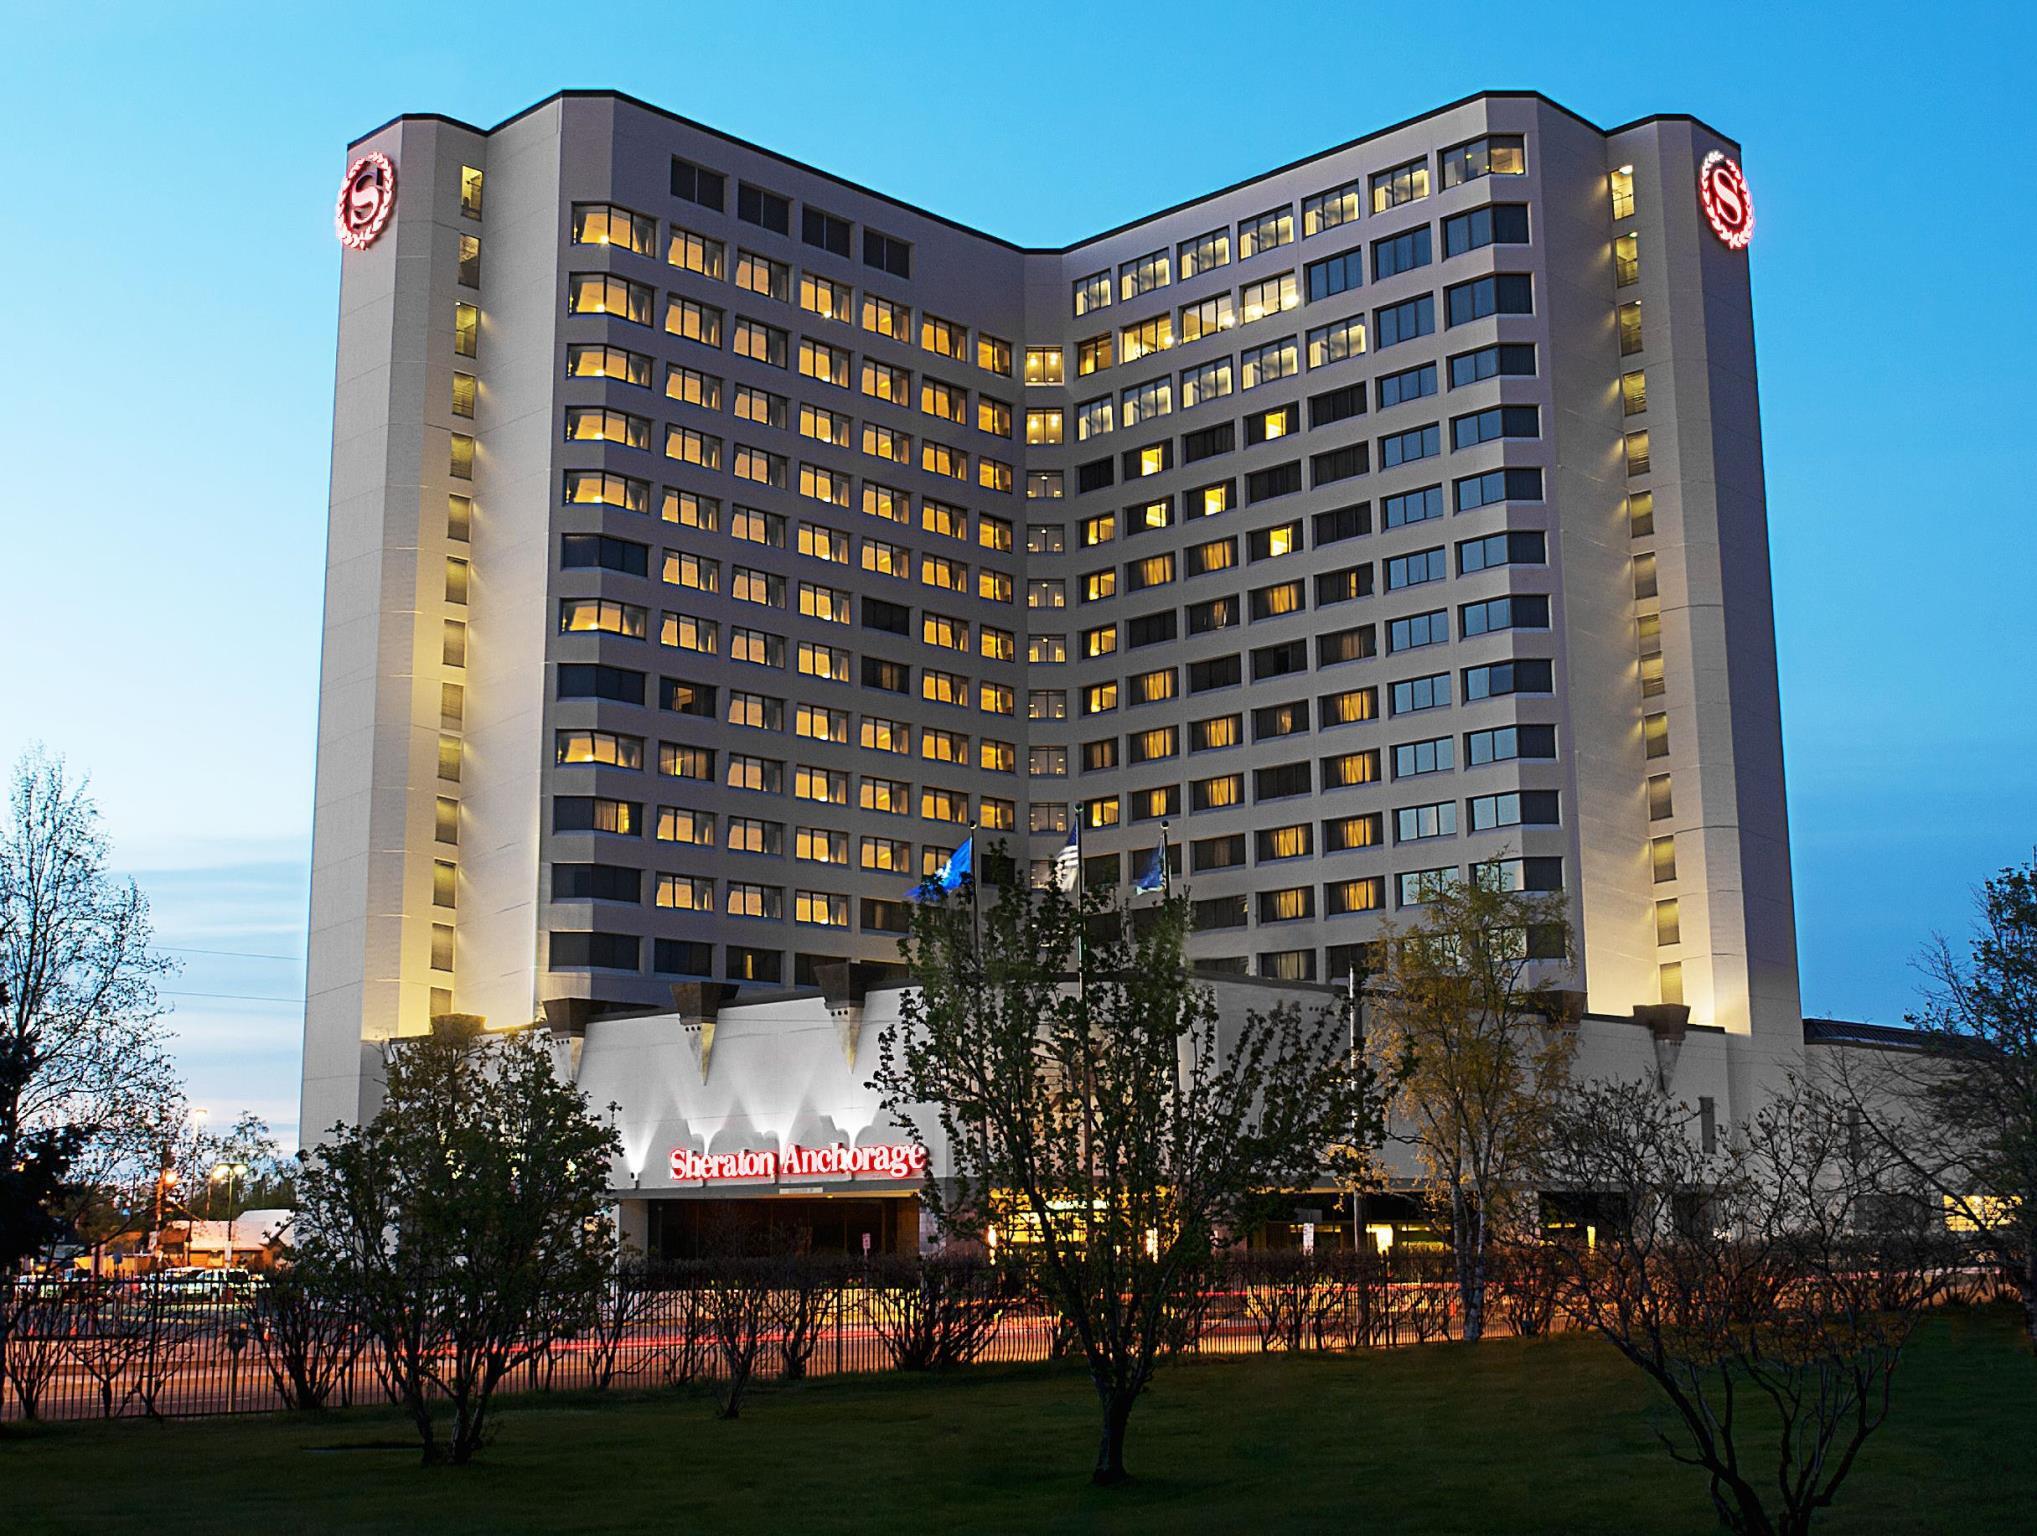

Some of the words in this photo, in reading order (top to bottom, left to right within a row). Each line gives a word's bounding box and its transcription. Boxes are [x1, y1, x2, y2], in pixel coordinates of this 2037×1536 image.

[1713, 168, 1742, 225] S
[669, 1149, 776, 1180] Sheraton
[782, 1143, 926, 1177] Anchorage
